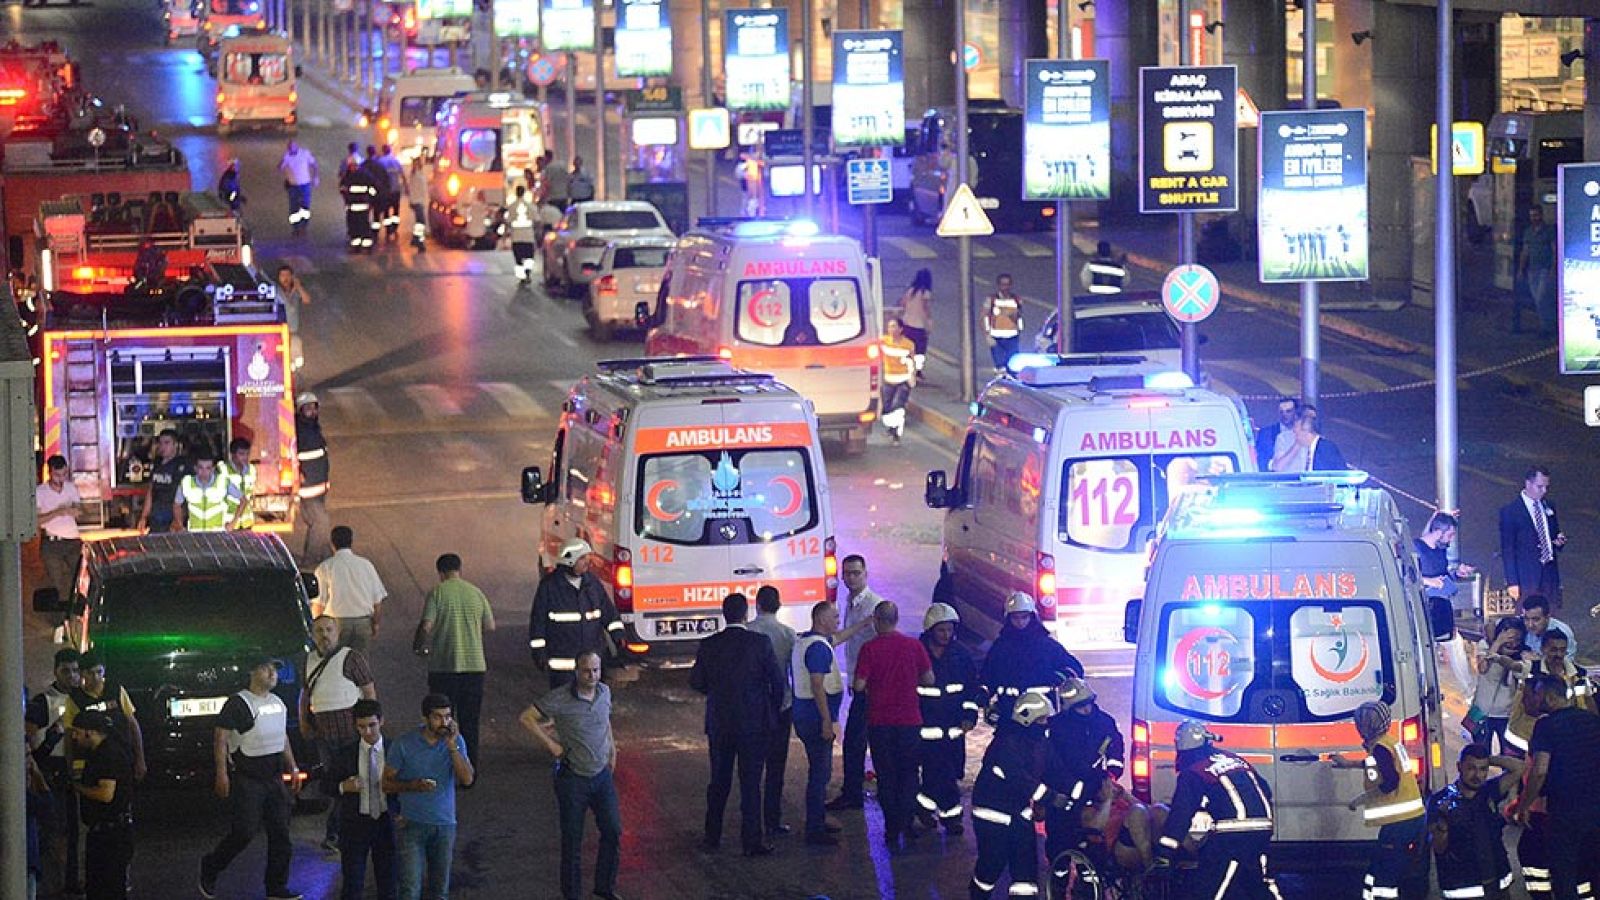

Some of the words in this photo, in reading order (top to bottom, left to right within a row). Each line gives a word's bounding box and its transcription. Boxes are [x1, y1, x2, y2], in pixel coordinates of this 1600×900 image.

[1170, 75, 1207, 88] ARAÇ
[1150, 177, 1186, 189] RENT
[1187, 177, 1199, 188] A
[1200, 176, 1229, 187] CAR
[1159, 192, 1219, 204] SHUTTLE
[743, 259, 848, 277] AMBULANS
[757, 302, 783, 317] 112
[666, 427, 773, 447] AMBULANS
[1081, 429, 1217, 451] AMBULANS
[1072, 476, 1136, 527] 112
[640, 545, 674, 563] 112
[787, 538, 820, 557] 112
[1181, 573, 1357, 600] AMBULANS
[1190, 651, 1230, 677] 112
